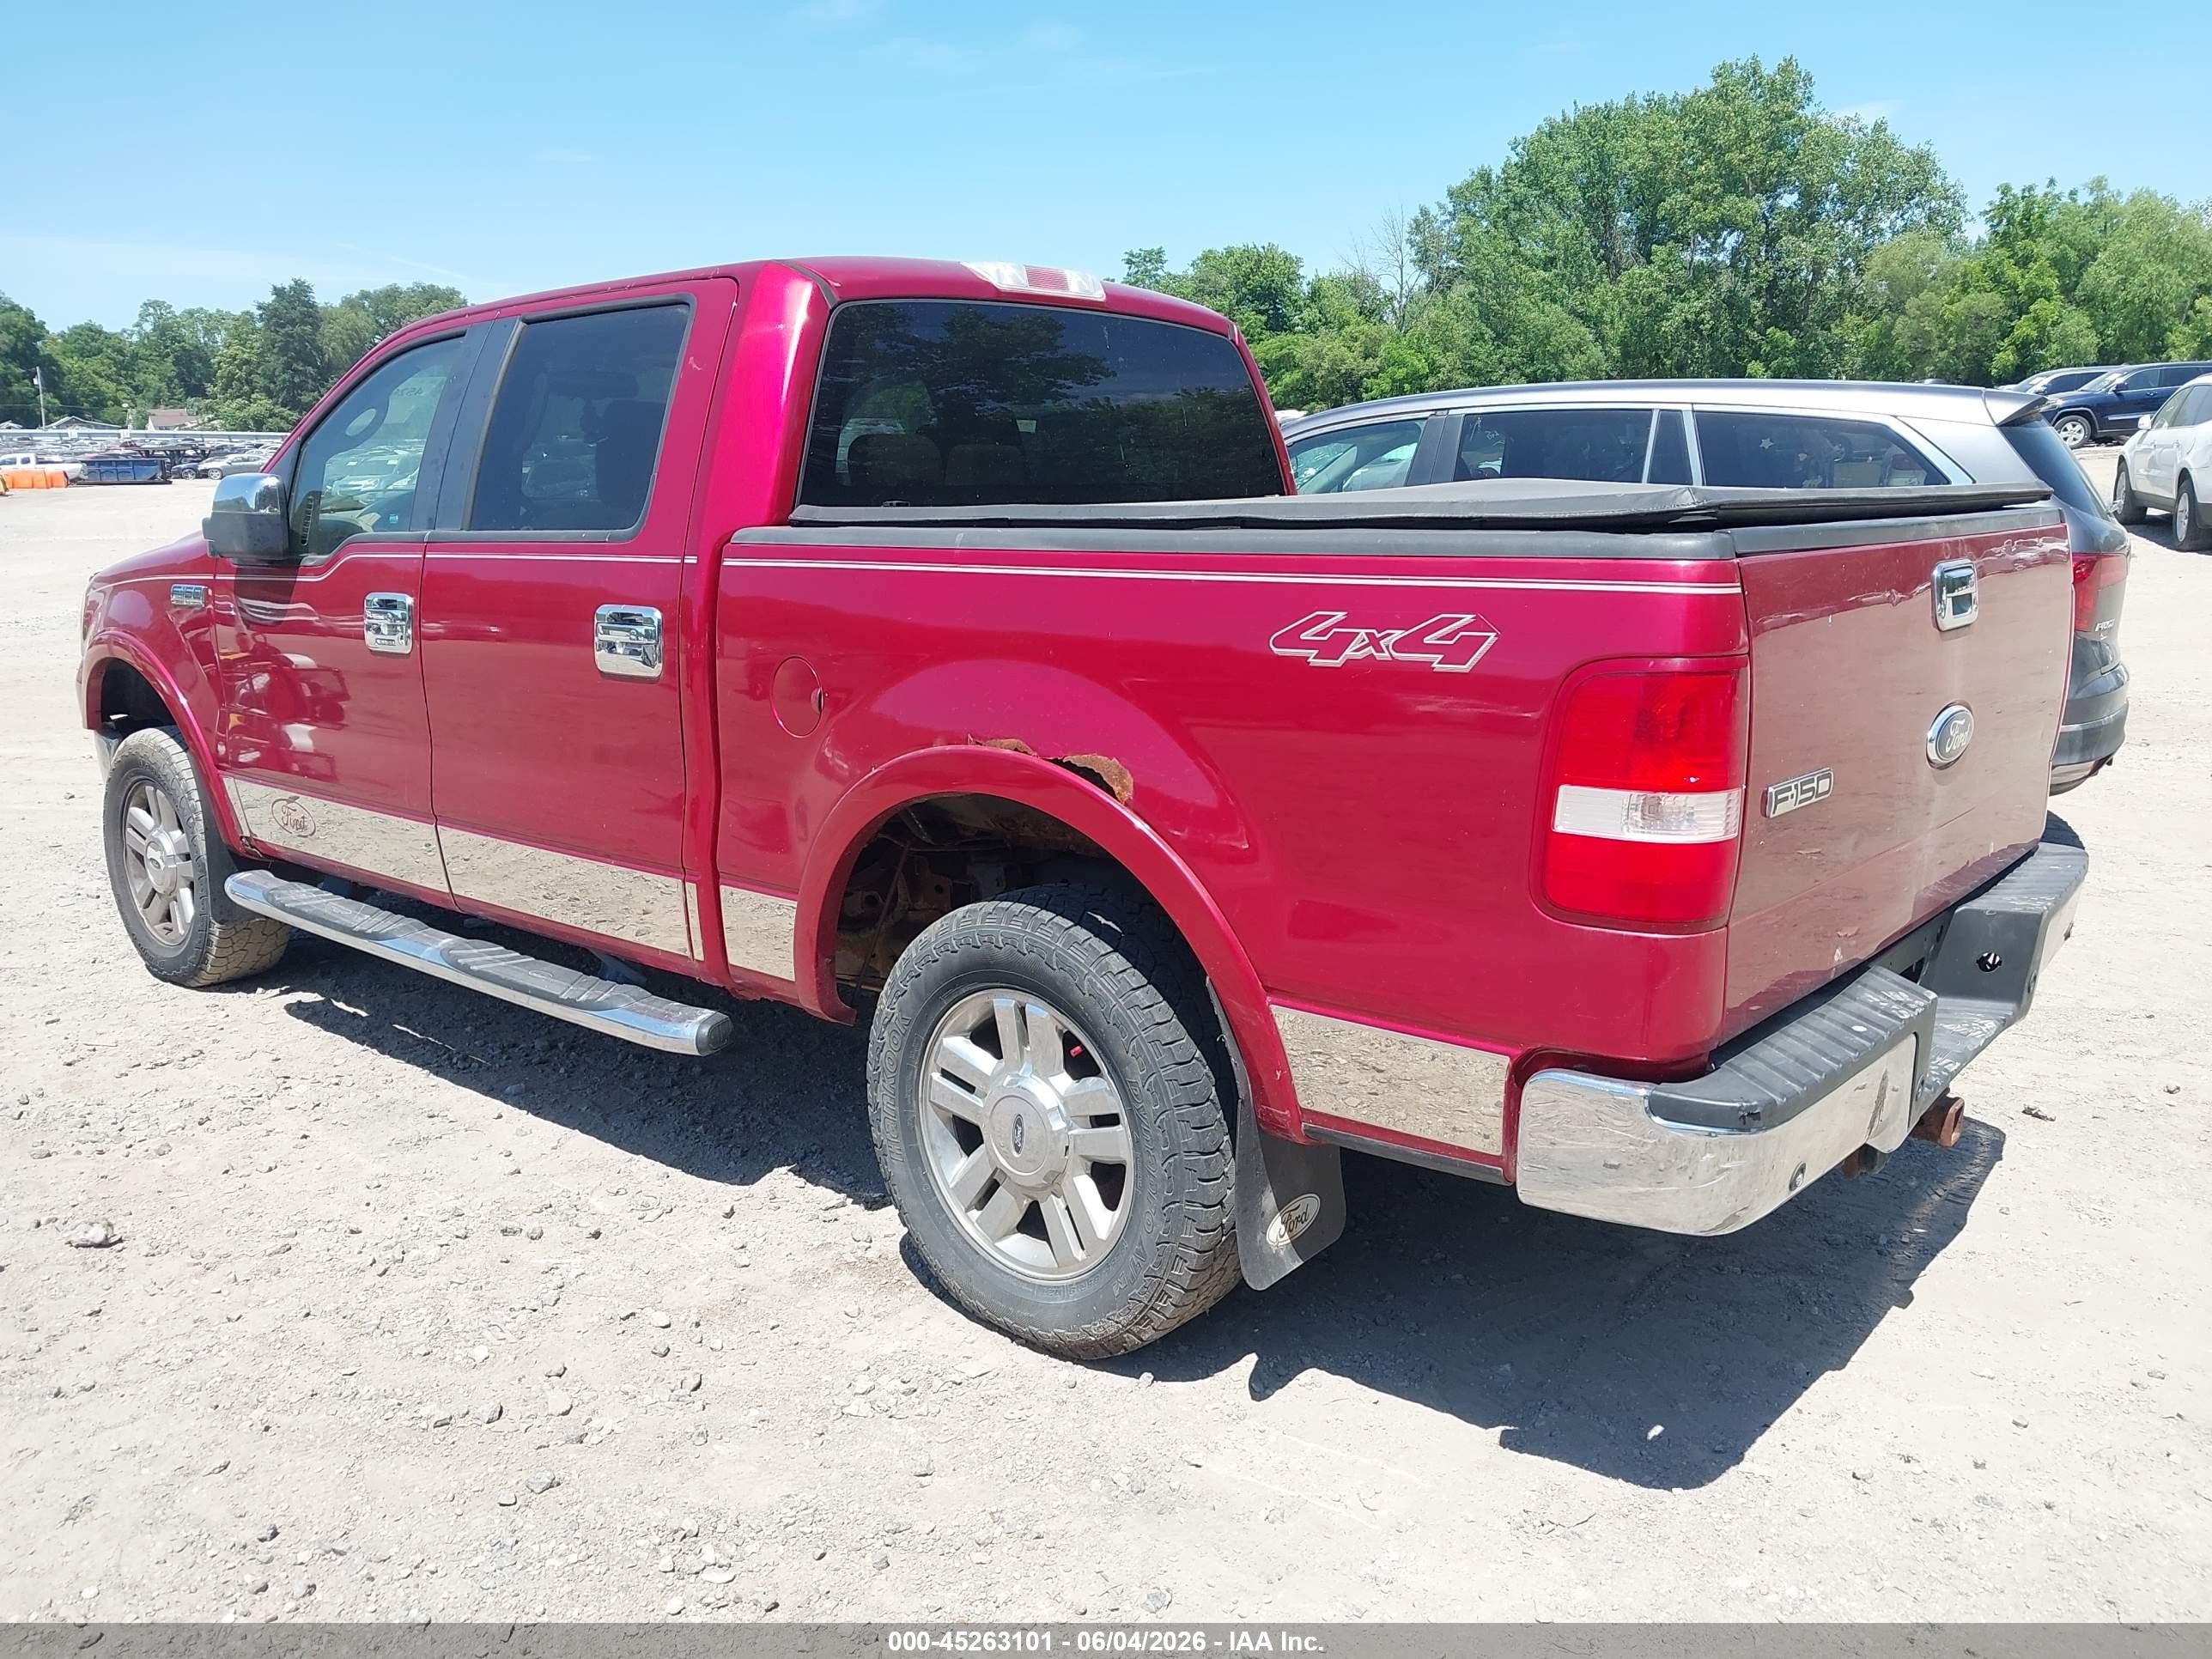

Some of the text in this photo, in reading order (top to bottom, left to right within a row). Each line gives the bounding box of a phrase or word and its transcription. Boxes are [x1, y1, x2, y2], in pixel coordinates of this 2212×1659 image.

[1268, 611, 1498, 673] 4x4
[1945, 719, 1971, 753] Ford
[1279, 1203, 1310, 1238] Ford
